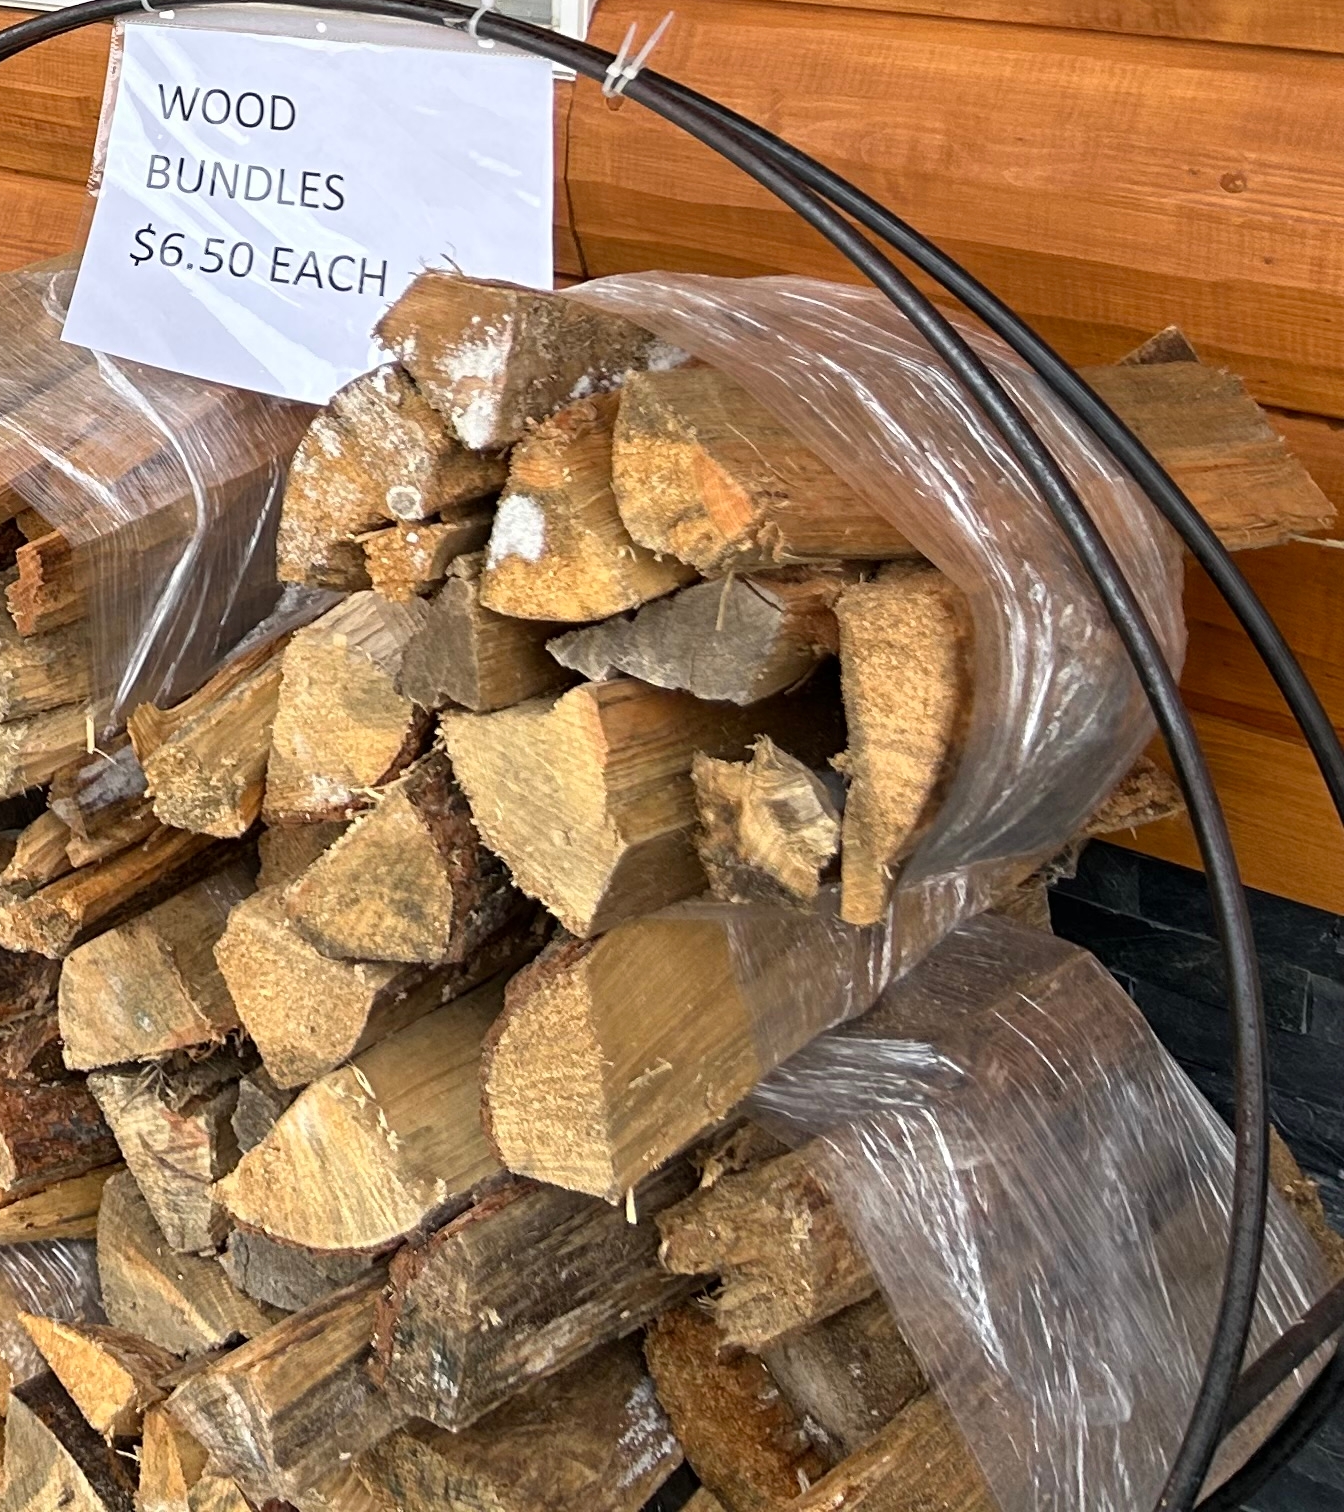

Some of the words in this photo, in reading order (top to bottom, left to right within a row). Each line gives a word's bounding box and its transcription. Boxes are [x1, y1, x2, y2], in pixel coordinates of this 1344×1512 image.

[157, 82, 297, 132] WOOD
[146, 154, 346, 212] BUNDLES
[128, 222, 255, 279] $6.50
[270, 246, 389, 297] EACH
